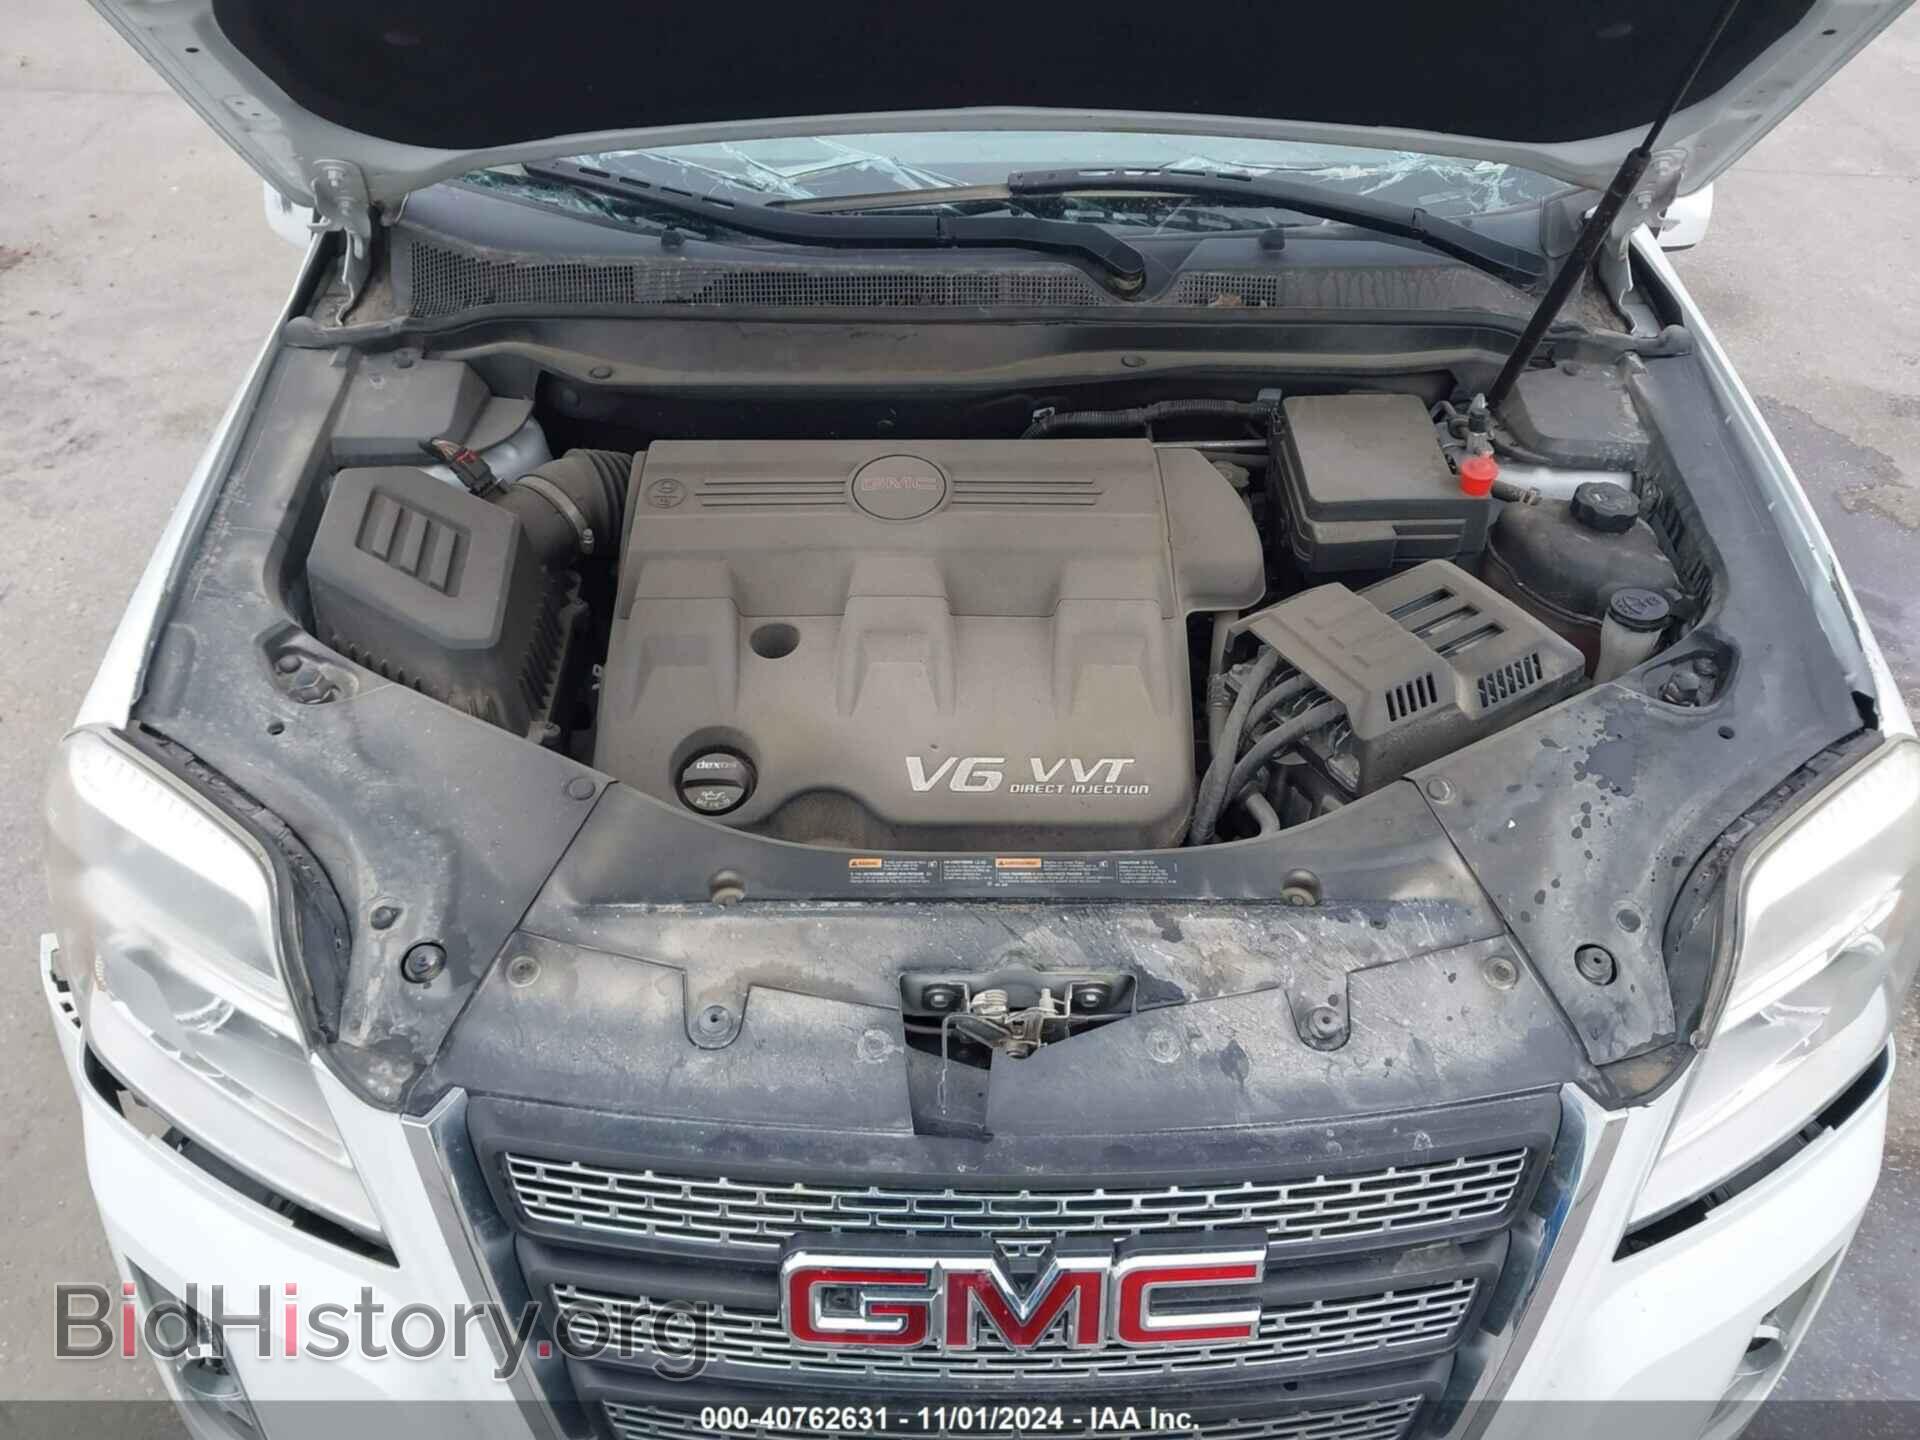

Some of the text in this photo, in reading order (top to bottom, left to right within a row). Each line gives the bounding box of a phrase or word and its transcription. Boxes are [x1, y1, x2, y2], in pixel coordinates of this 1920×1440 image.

[905, 756, 1136, 792] V6 VVT
[1010, 784, 1065, 794] DIRECT
[780, 1249, 1268, 1350] GMC
